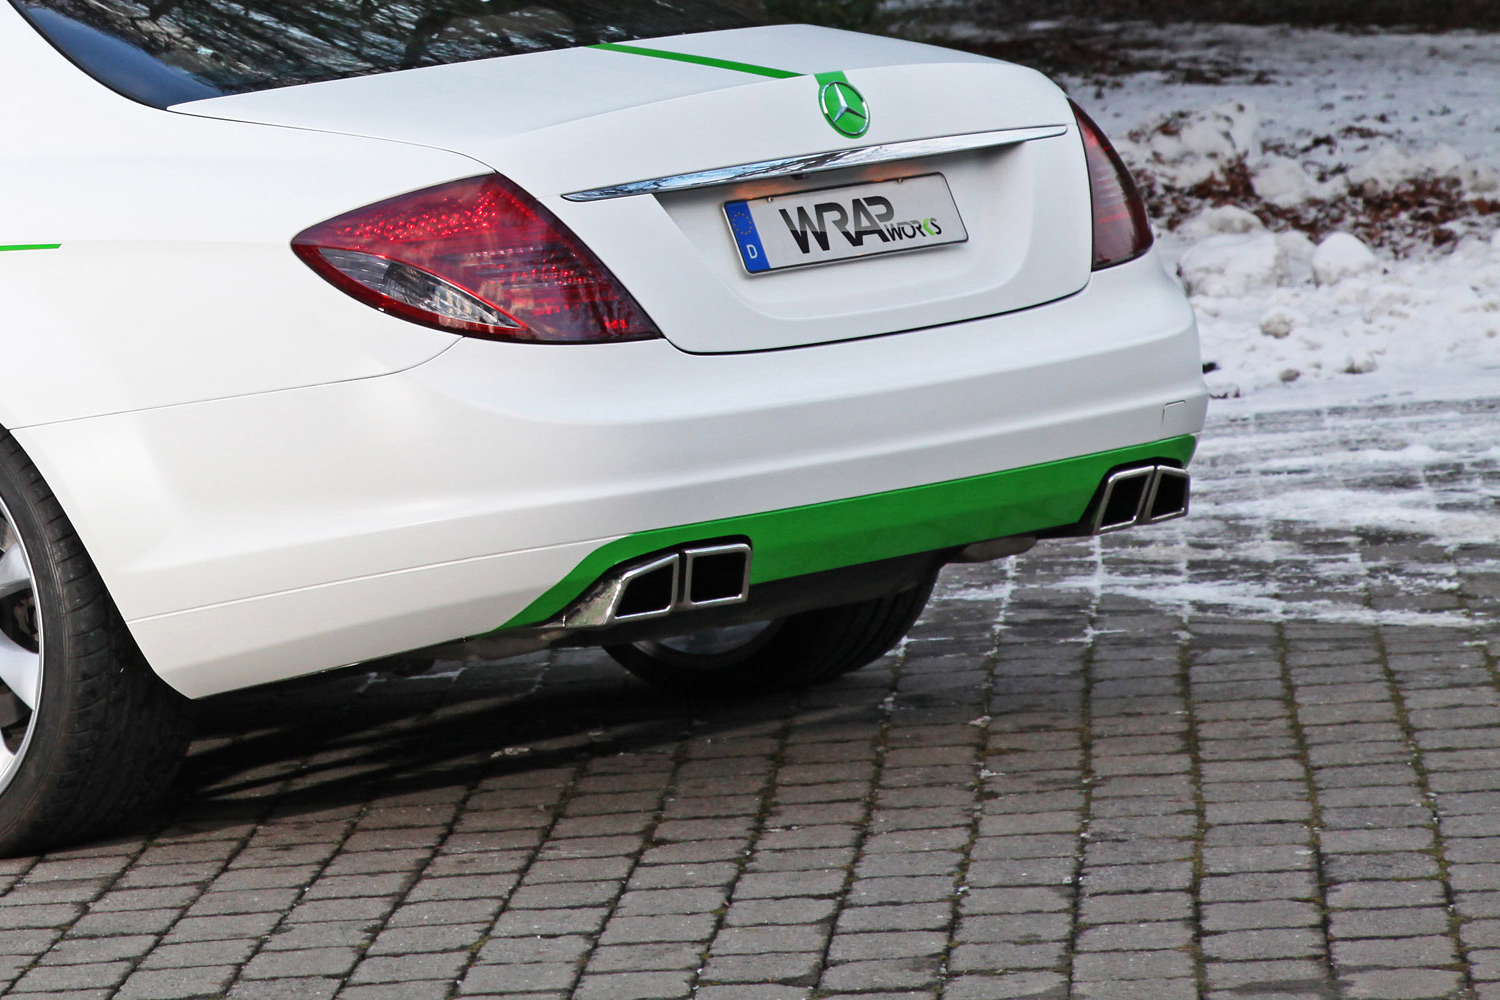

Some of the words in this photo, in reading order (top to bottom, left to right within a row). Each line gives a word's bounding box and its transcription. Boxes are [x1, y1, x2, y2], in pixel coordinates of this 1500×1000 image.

[779, 195, 895, 254] WRAP
[885, 217, 942, 242] WORKS
[746, 243, 758, 259] D
